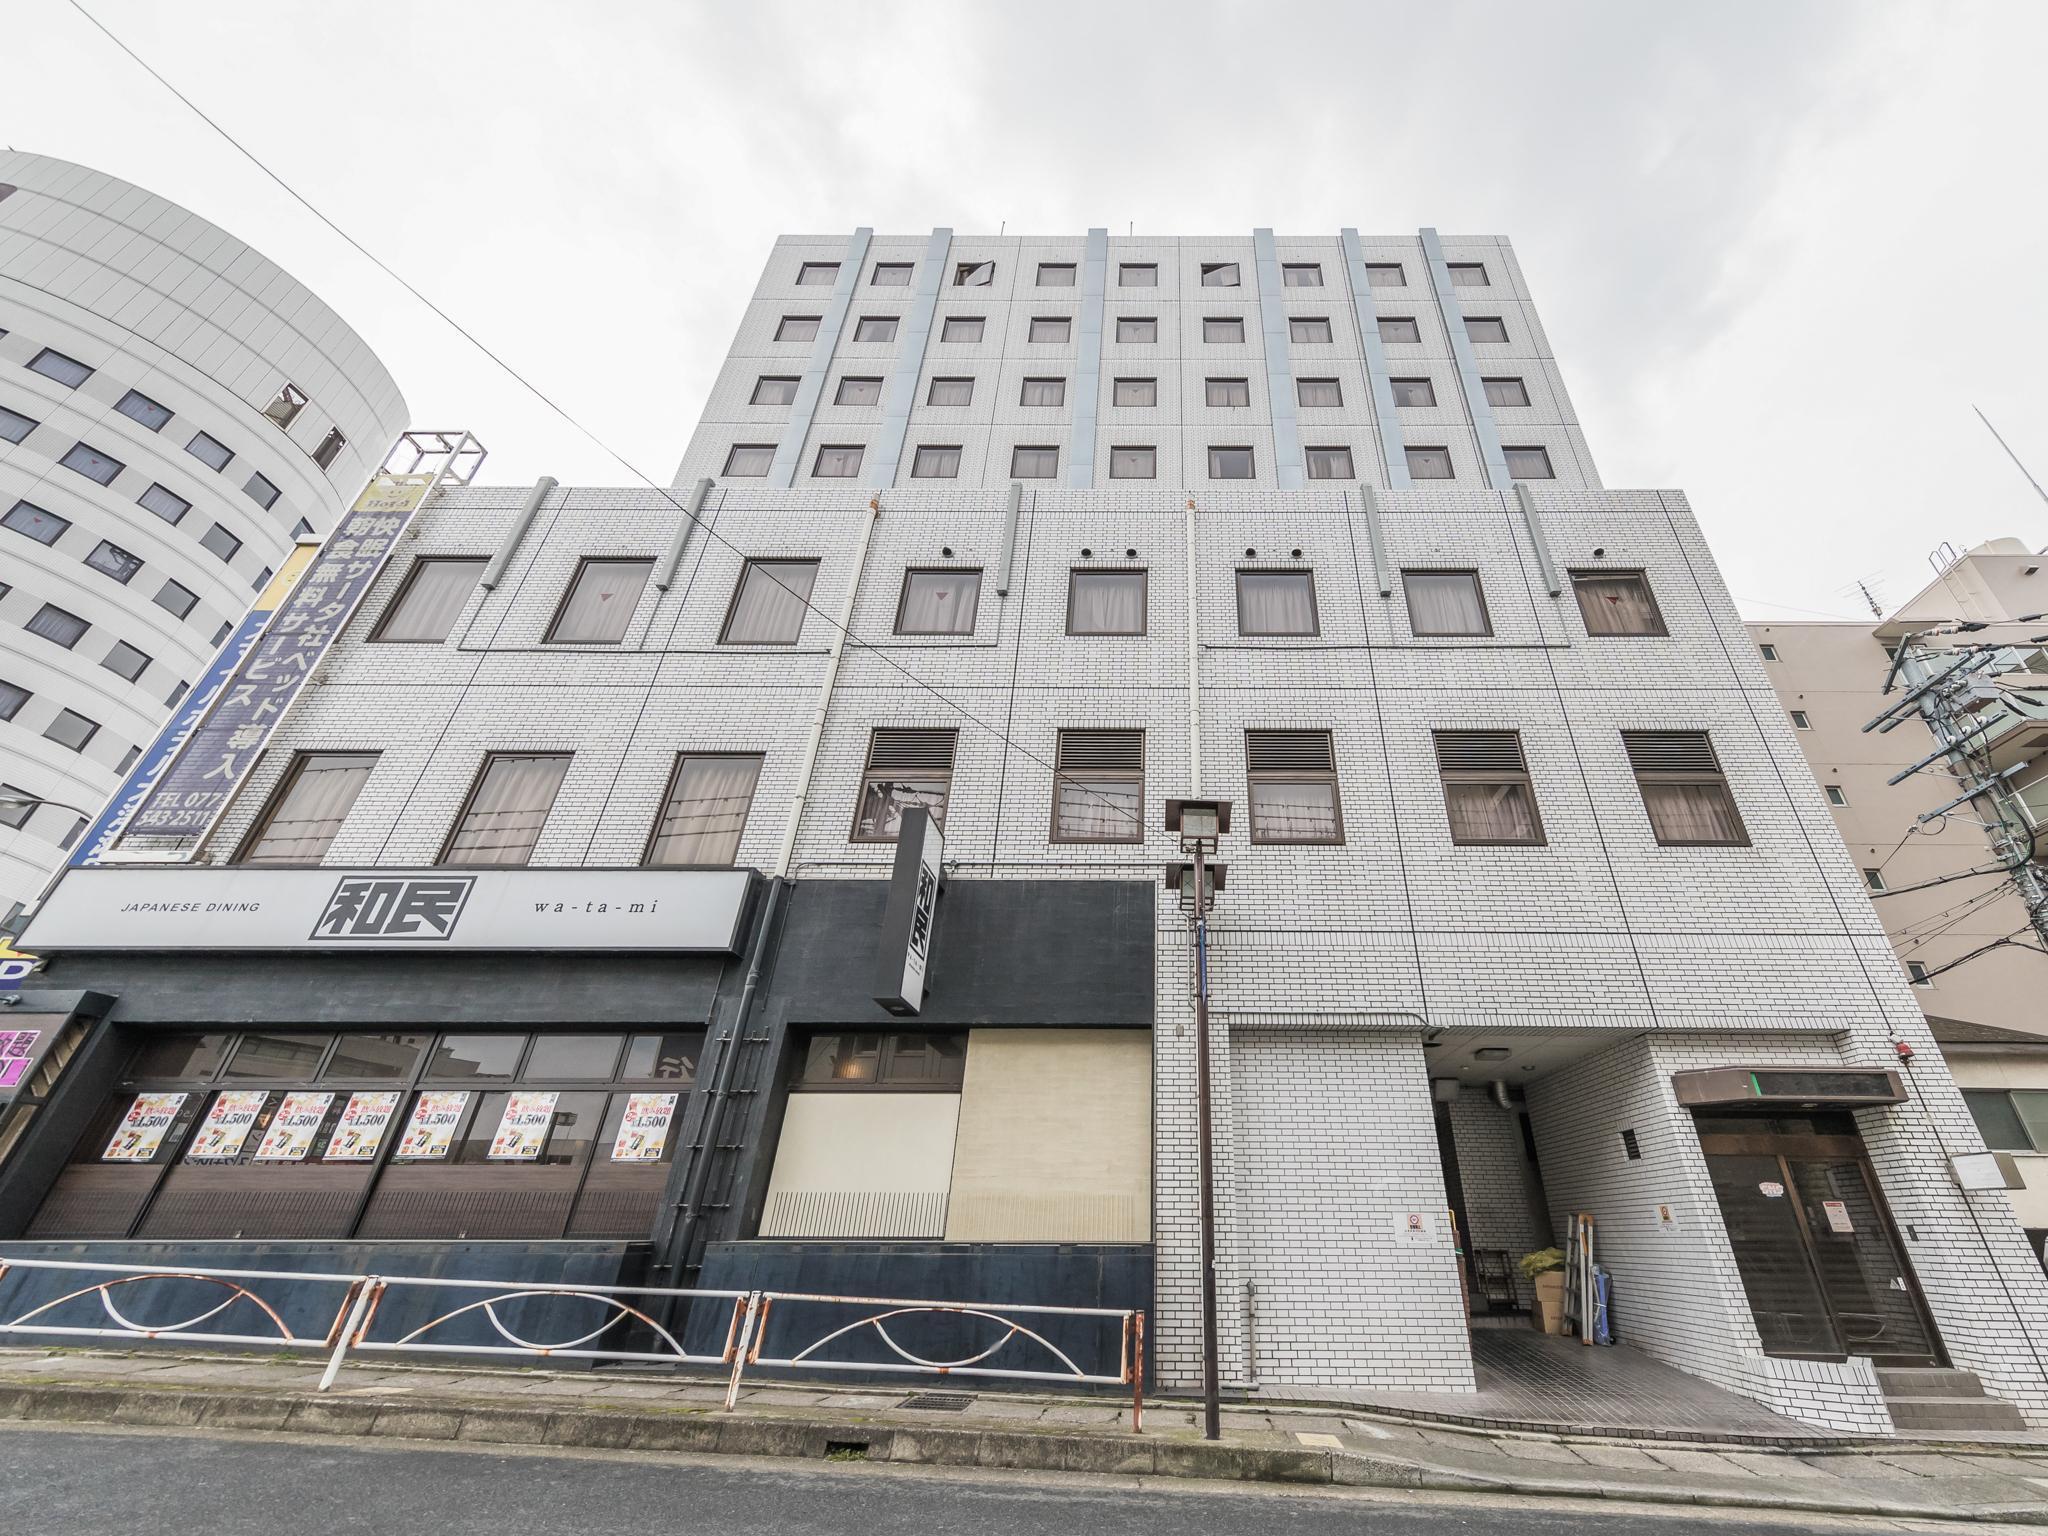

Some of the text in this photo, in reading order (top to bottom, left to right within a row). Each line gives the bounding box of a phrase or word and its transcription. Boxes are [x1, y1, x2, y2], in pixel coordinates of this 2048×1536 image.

[223, 517, 377, 706] 朝食無料サービス
[149, 791, 182, 808] TEL
[120, 902, 261, 912] JAPANESE DINING
[320, 881, 468, 935] 和民
